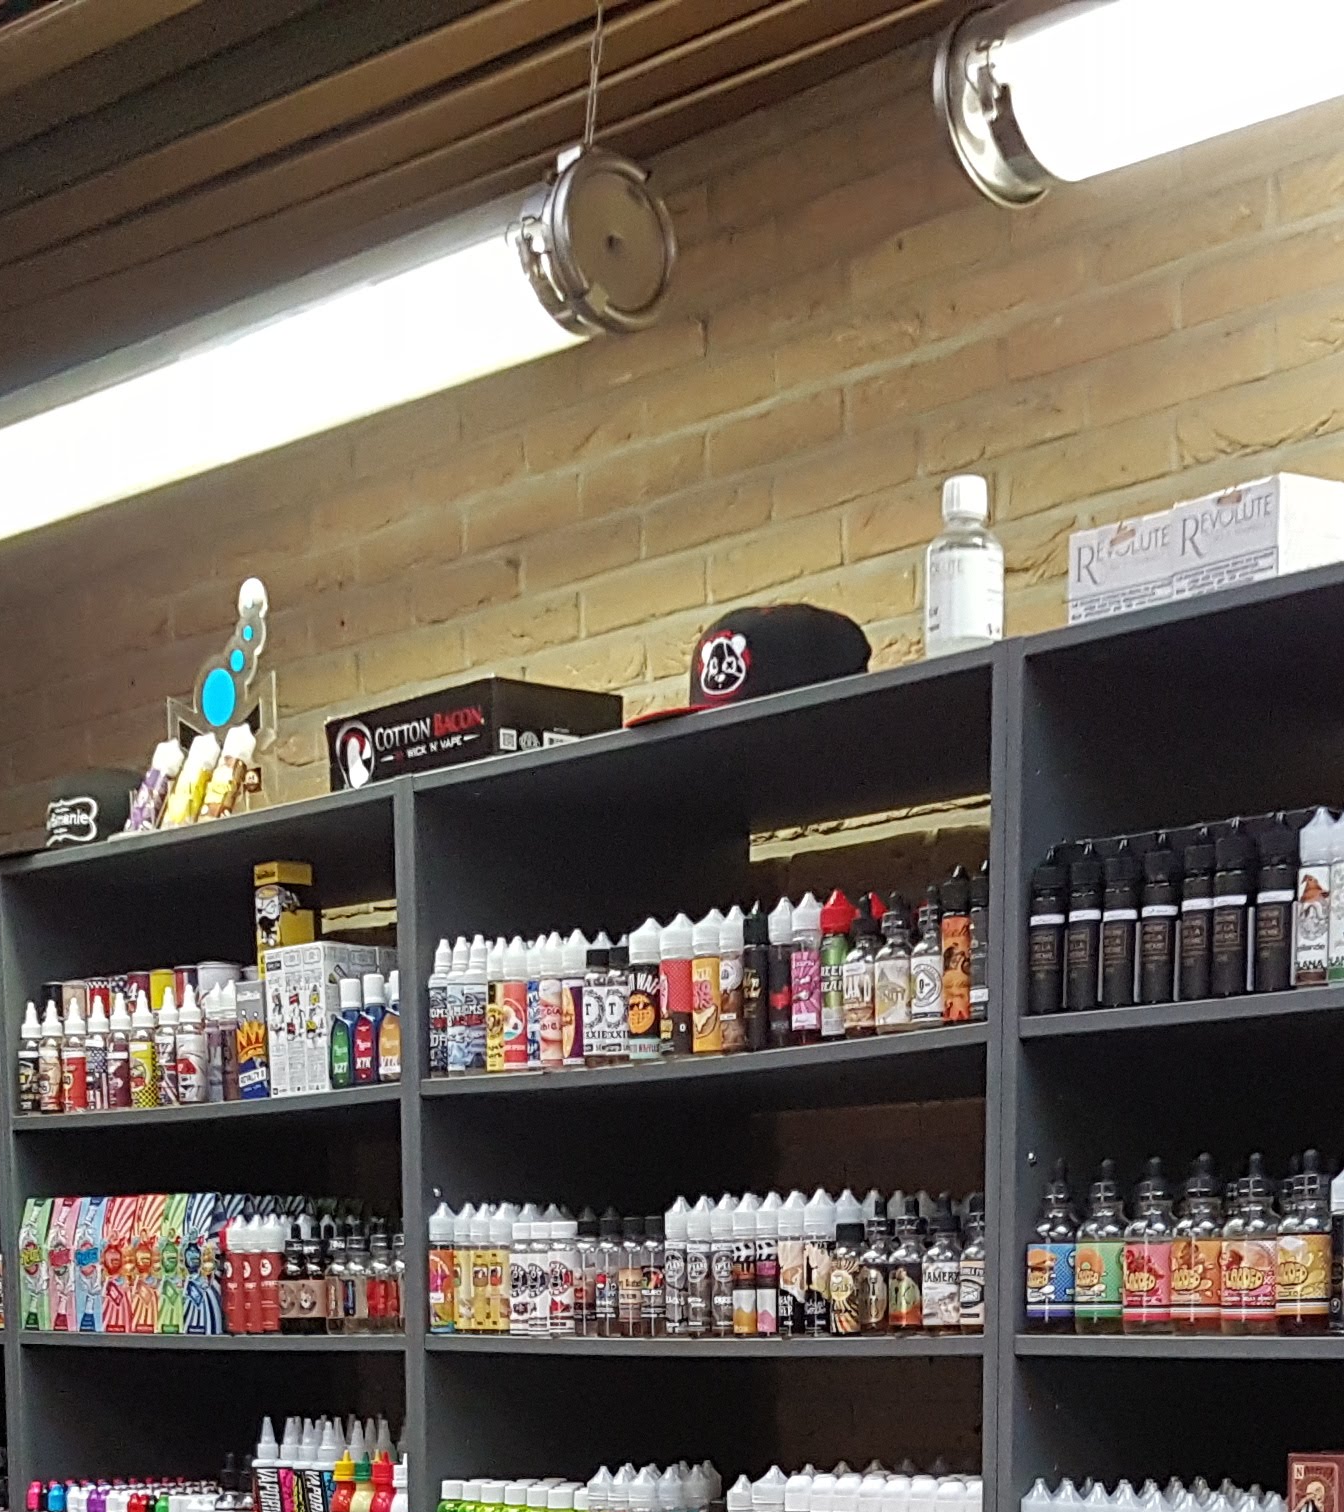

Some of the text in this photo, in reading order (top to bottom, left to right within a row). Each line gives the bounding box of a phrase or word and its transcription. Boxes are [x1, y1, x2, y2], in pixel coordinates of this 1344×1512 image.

[375, 705, 484, 751] COTTON BACON
[1225, 1270, 1265, 1288] LOADED
